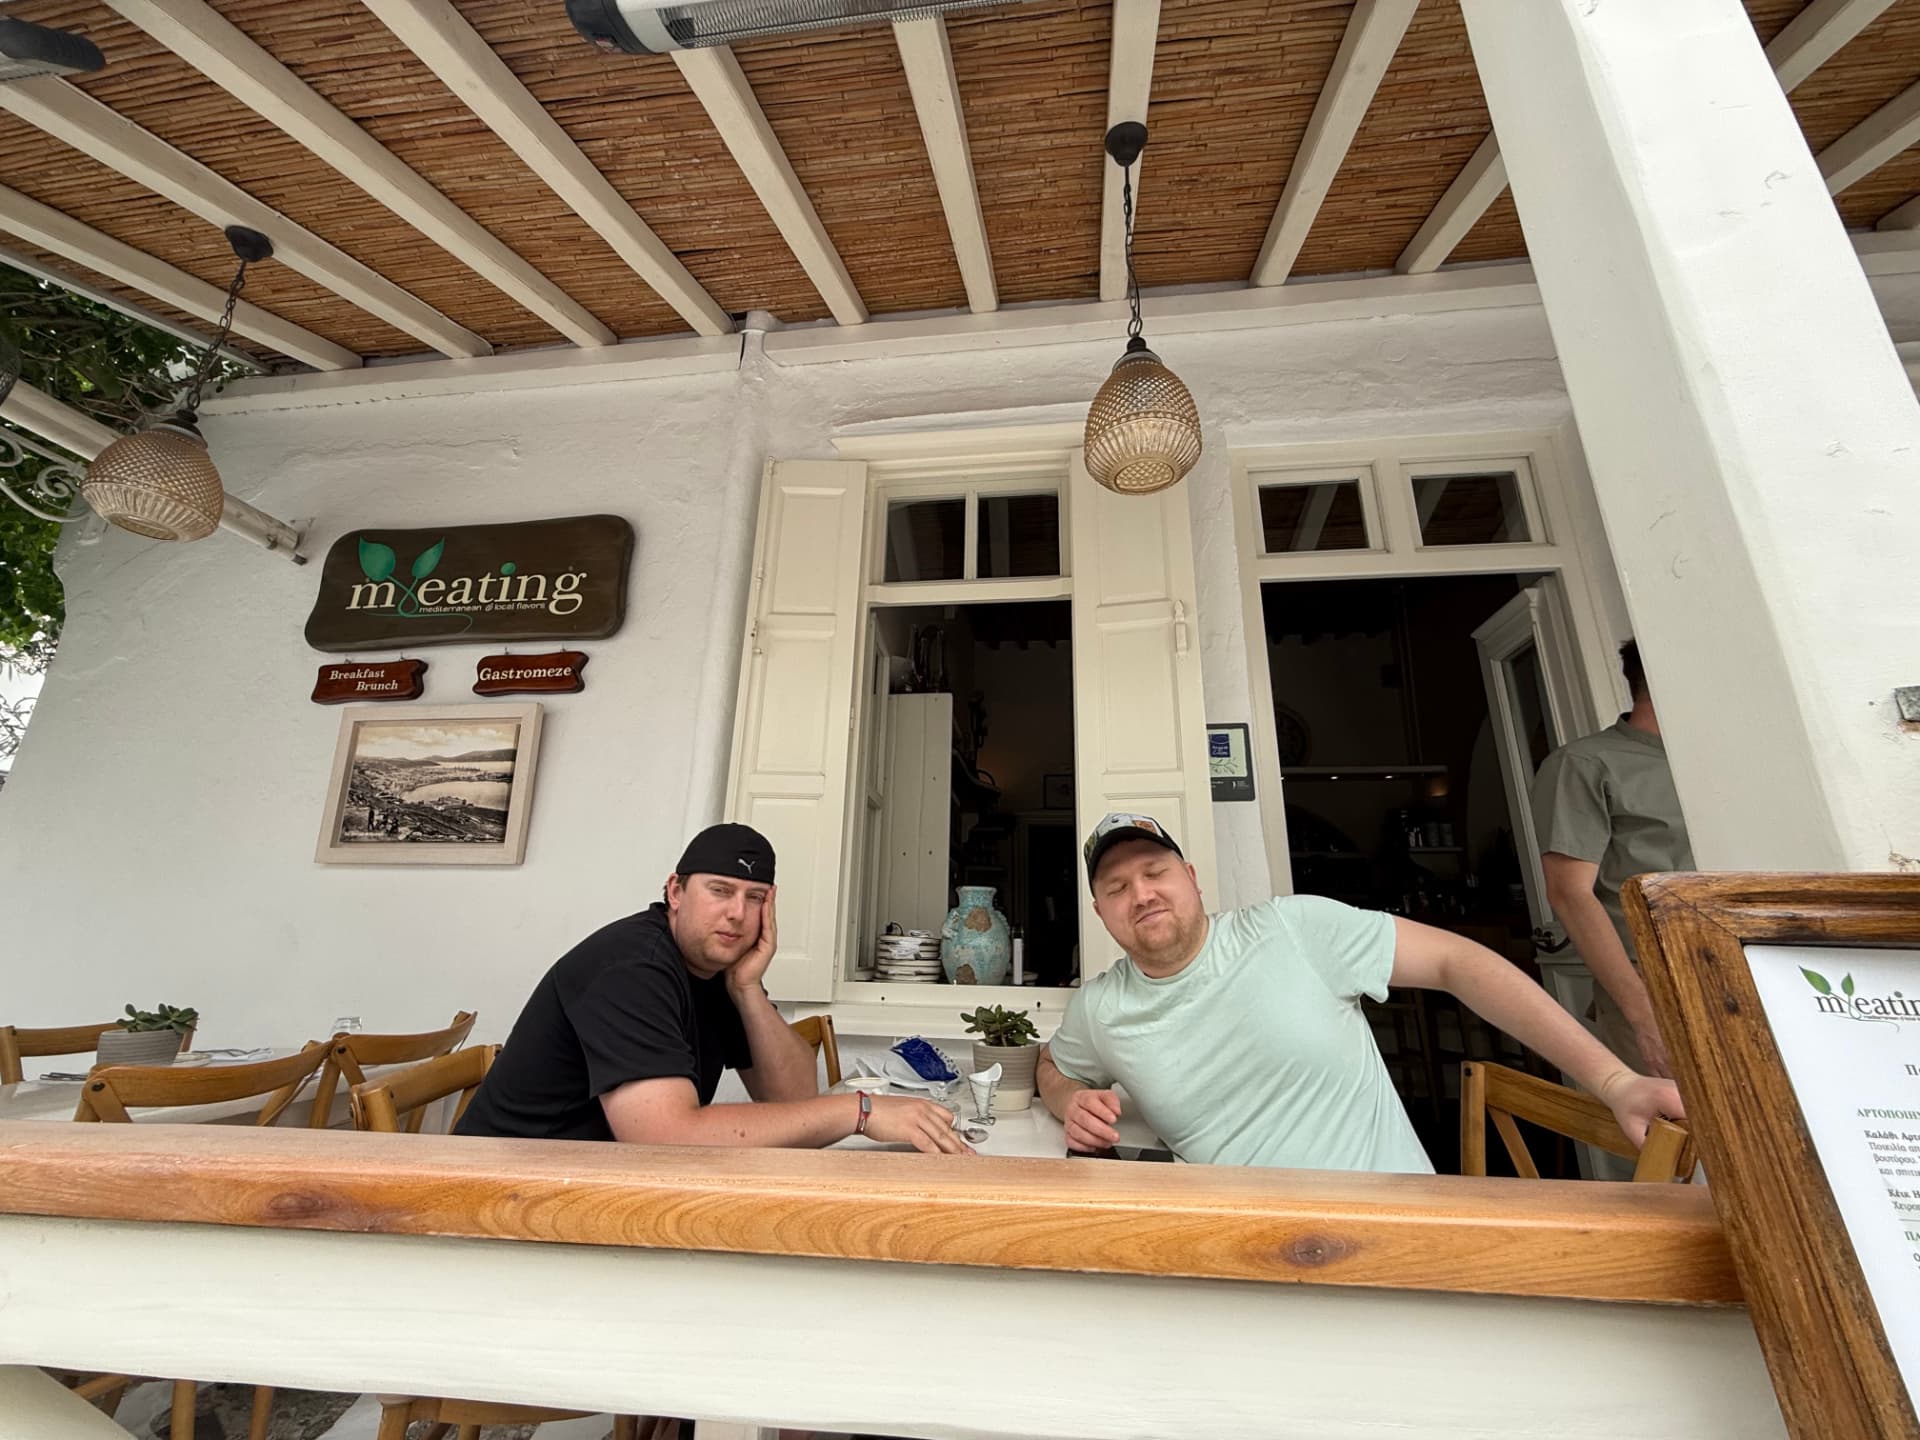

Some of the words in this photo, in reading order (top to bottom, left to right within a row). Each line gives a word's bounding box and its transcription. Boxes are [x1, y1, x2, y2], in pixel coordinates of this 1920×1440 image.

[418, 604, 482, 613] mediterranean
[494, 602, 515, 611] local
[516, 601, 546, 610] flavors
[329, 669, 385, 681] Breakfast
[479, 666, 572, 681] Gastromeze
[356, 681, 398, 691] Brunch
